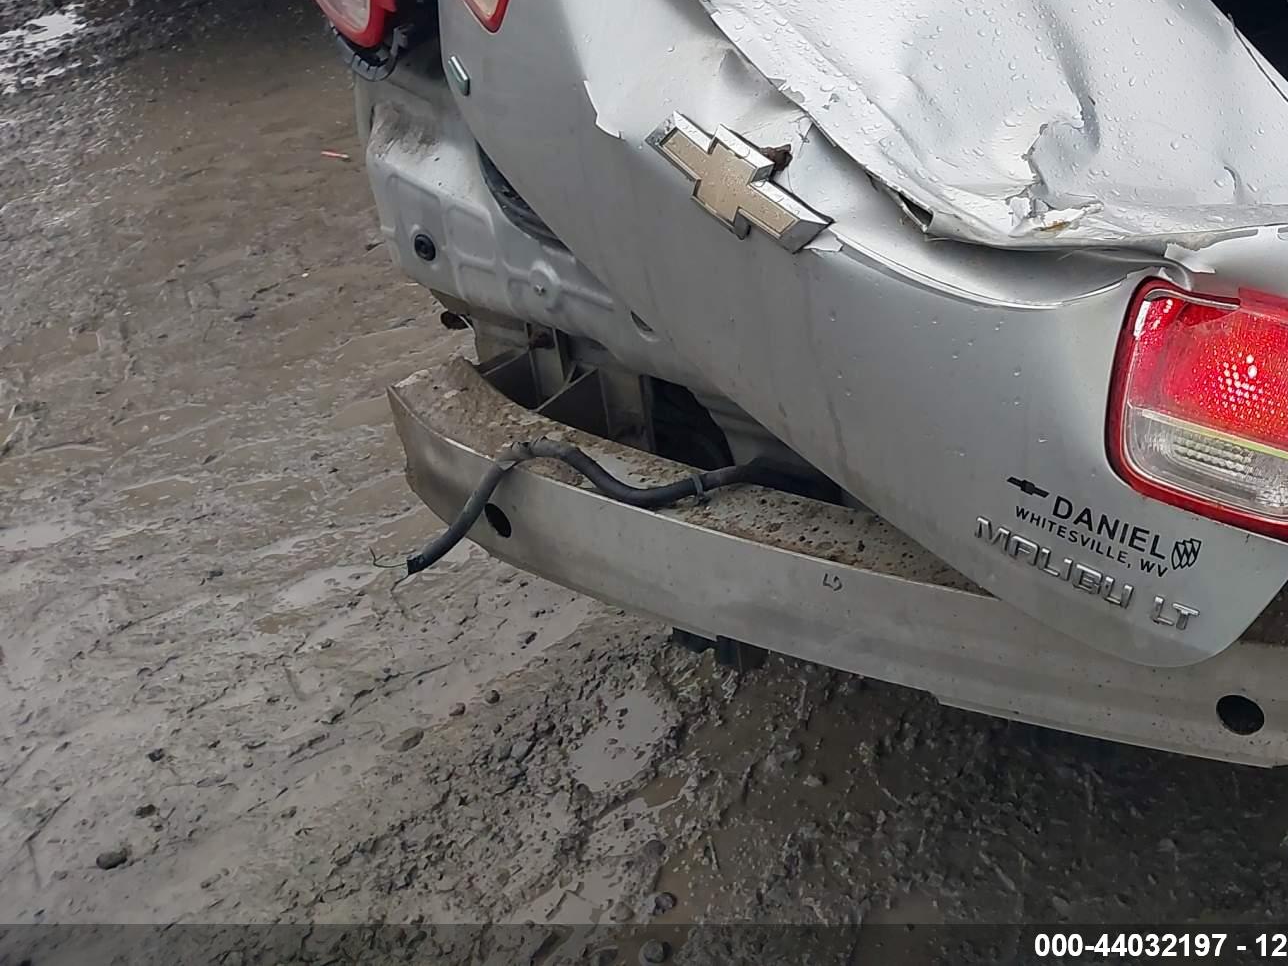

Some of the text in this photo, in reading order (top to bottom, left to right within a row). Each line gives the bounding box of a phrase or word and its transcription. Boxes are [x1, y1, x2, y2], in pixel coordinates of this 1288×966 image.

[1015, 505, 1168, 578] WHITESVILLE, WV
[1051, 495, 1166, 560] DANIEL
[974, 516, 1200, 630] MALIBU LT
